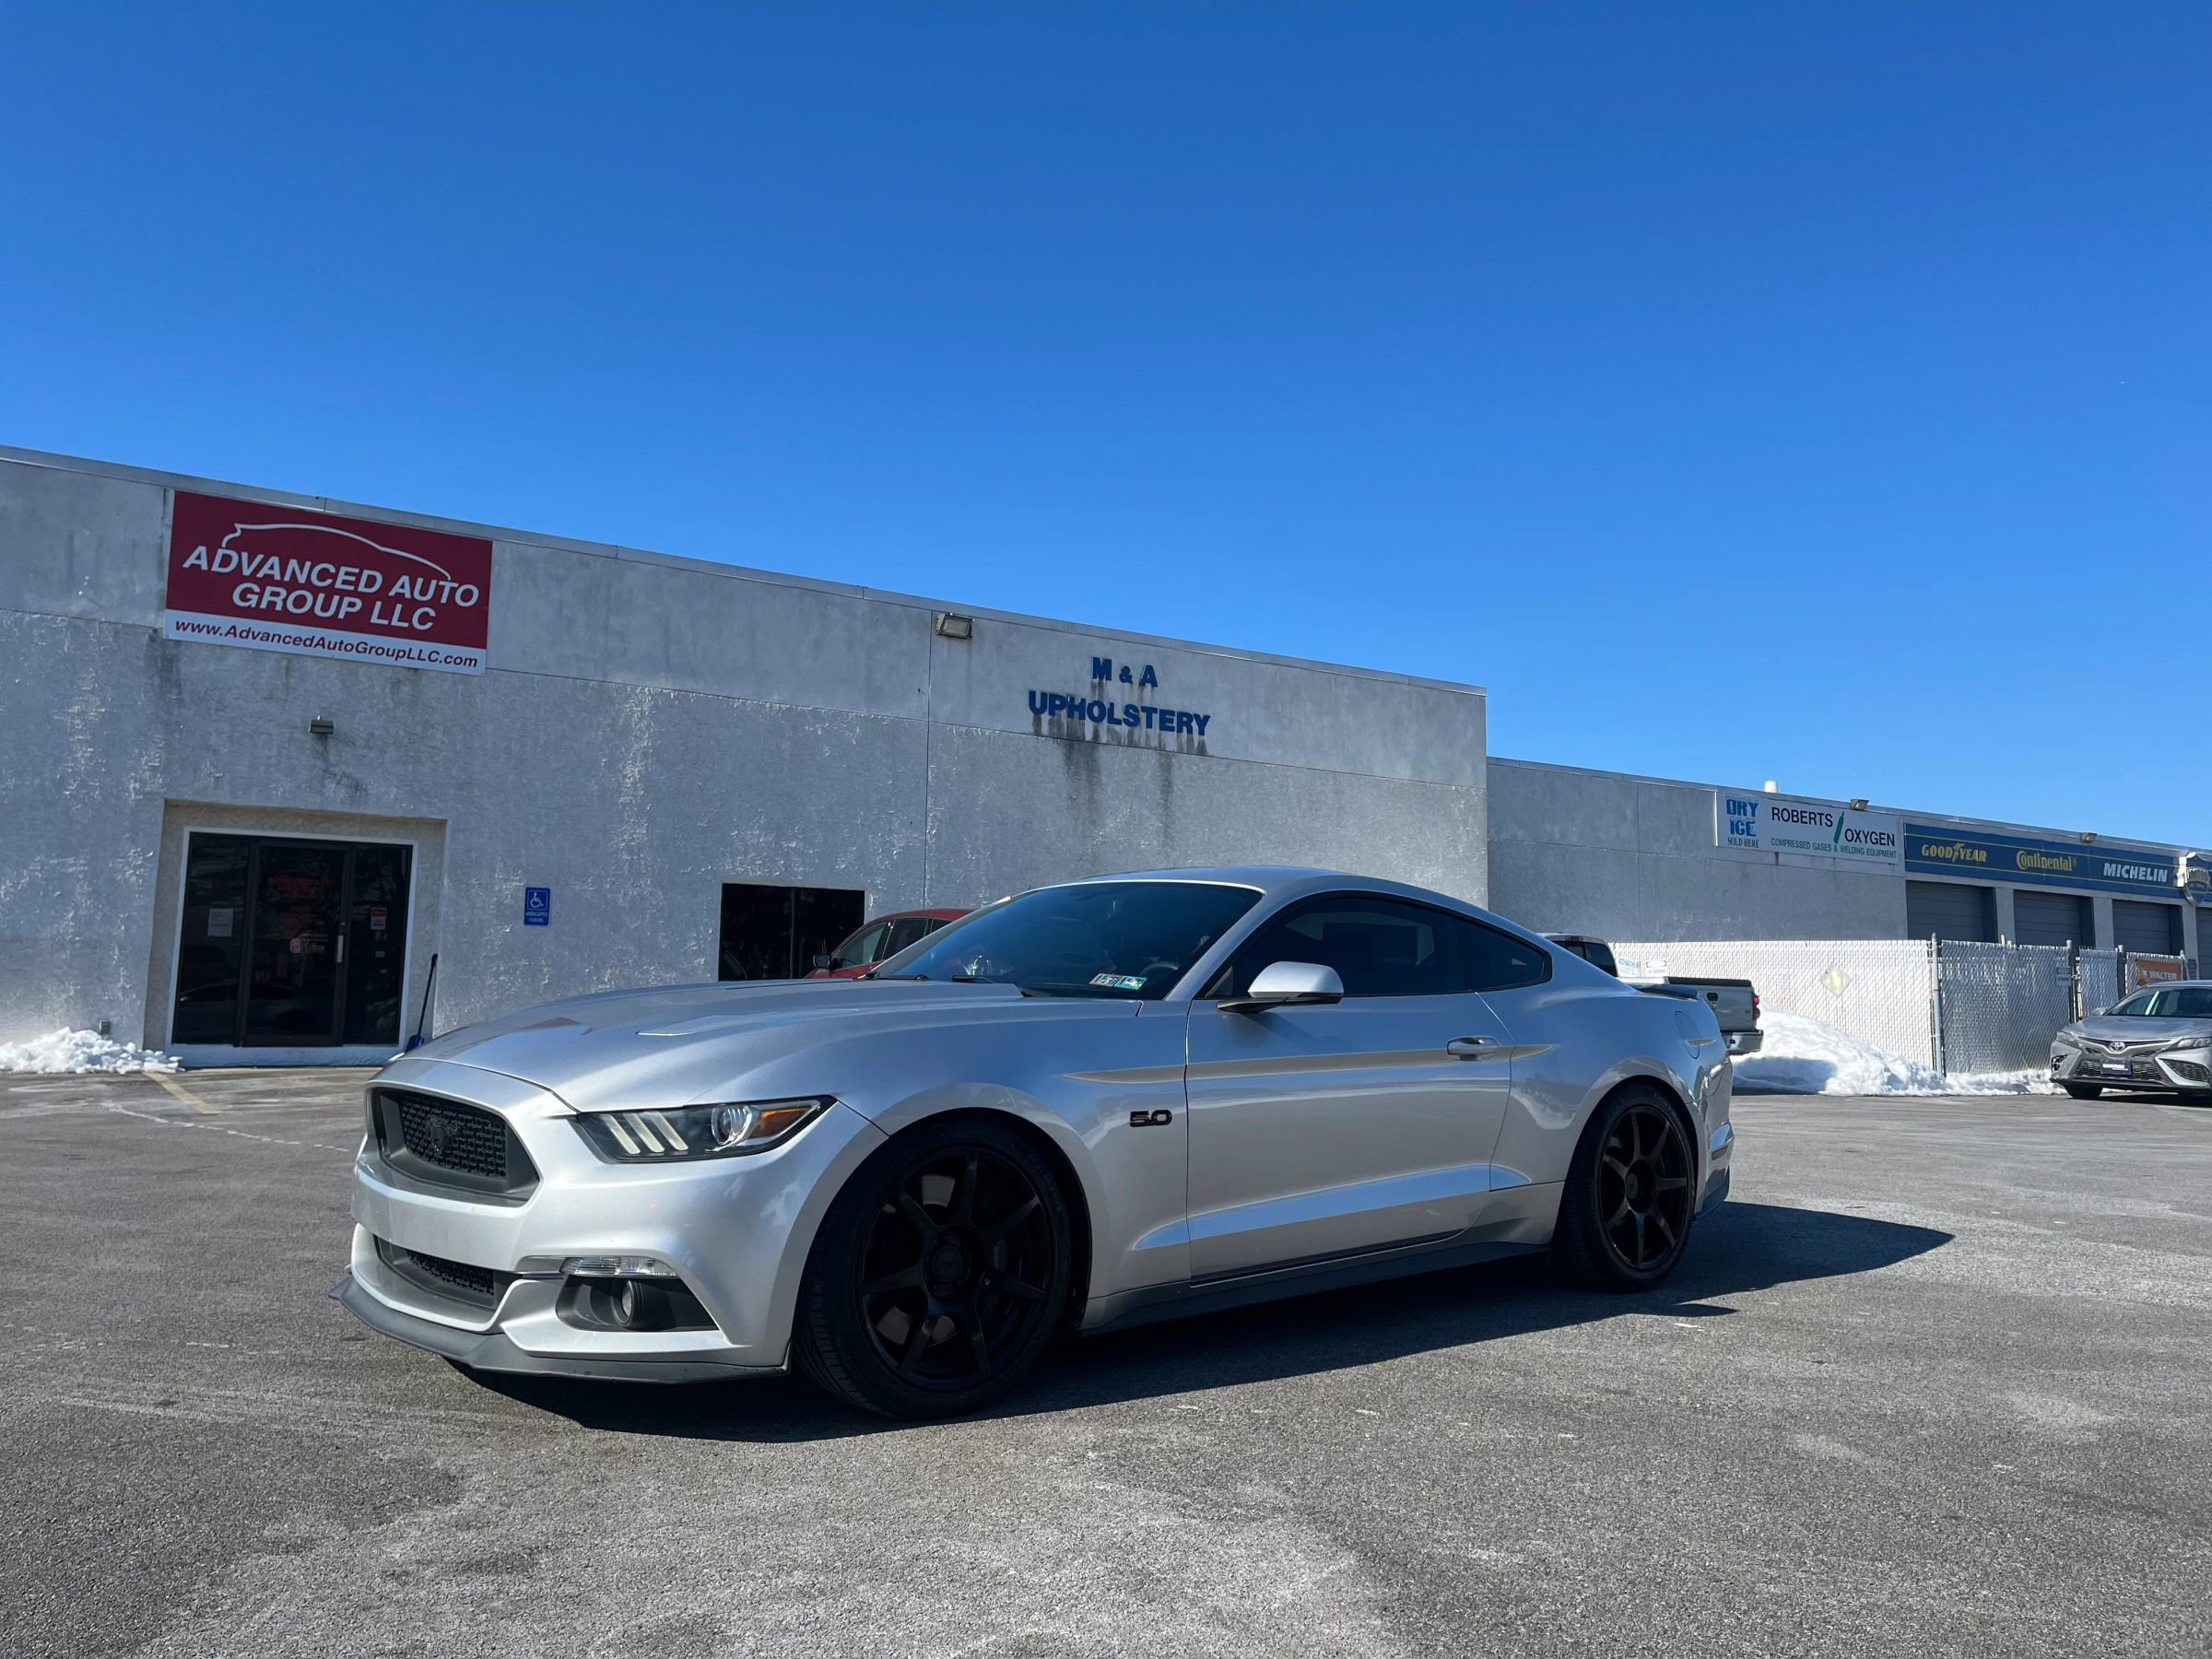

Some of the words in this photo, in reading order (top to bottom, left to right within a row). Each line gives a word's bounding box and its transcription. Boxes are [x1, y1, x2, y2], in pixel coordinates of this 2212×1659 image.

[182, 545, 383, 594] ADVANCED
[388, 574, 479, 608] AUTO
[232, 582, 362, 620] GROUP
[370, 603, 436, 630] LLC
[175, 618, 478, 668] www.AdvancedAutoGroupLLC.com
[1091, 656, 1112, 681] M
[1119, 665, 1134, 684] &
[1138, 665, 1159, 688] A
[1029, 690, 1211, 735] UPHOLSTERY
[1725, 797, 1759, 818] DRY
[1771, 806, 1833, 828] ROBERTS
[1730, 818, 1757, 837] ICE
[1844, 828, 1896, 847] OXYGEN
[1727, 837, 1743, 847] SOLD
[1744, 839, 1759, 848] HERE
[1771, 838, 1811, 850] COMPRESSED
[1813, 841, 1832, 852] GASES
[1841, 845, 1865, 855] WELDING
[1866, 848, 1897, 858] EQUIPMENT
[2016, 850, 2073, 872] Continental
[2102, 862, 2168, 883] MICHELIN
[2149, 971, 2178, 981] WALTER
